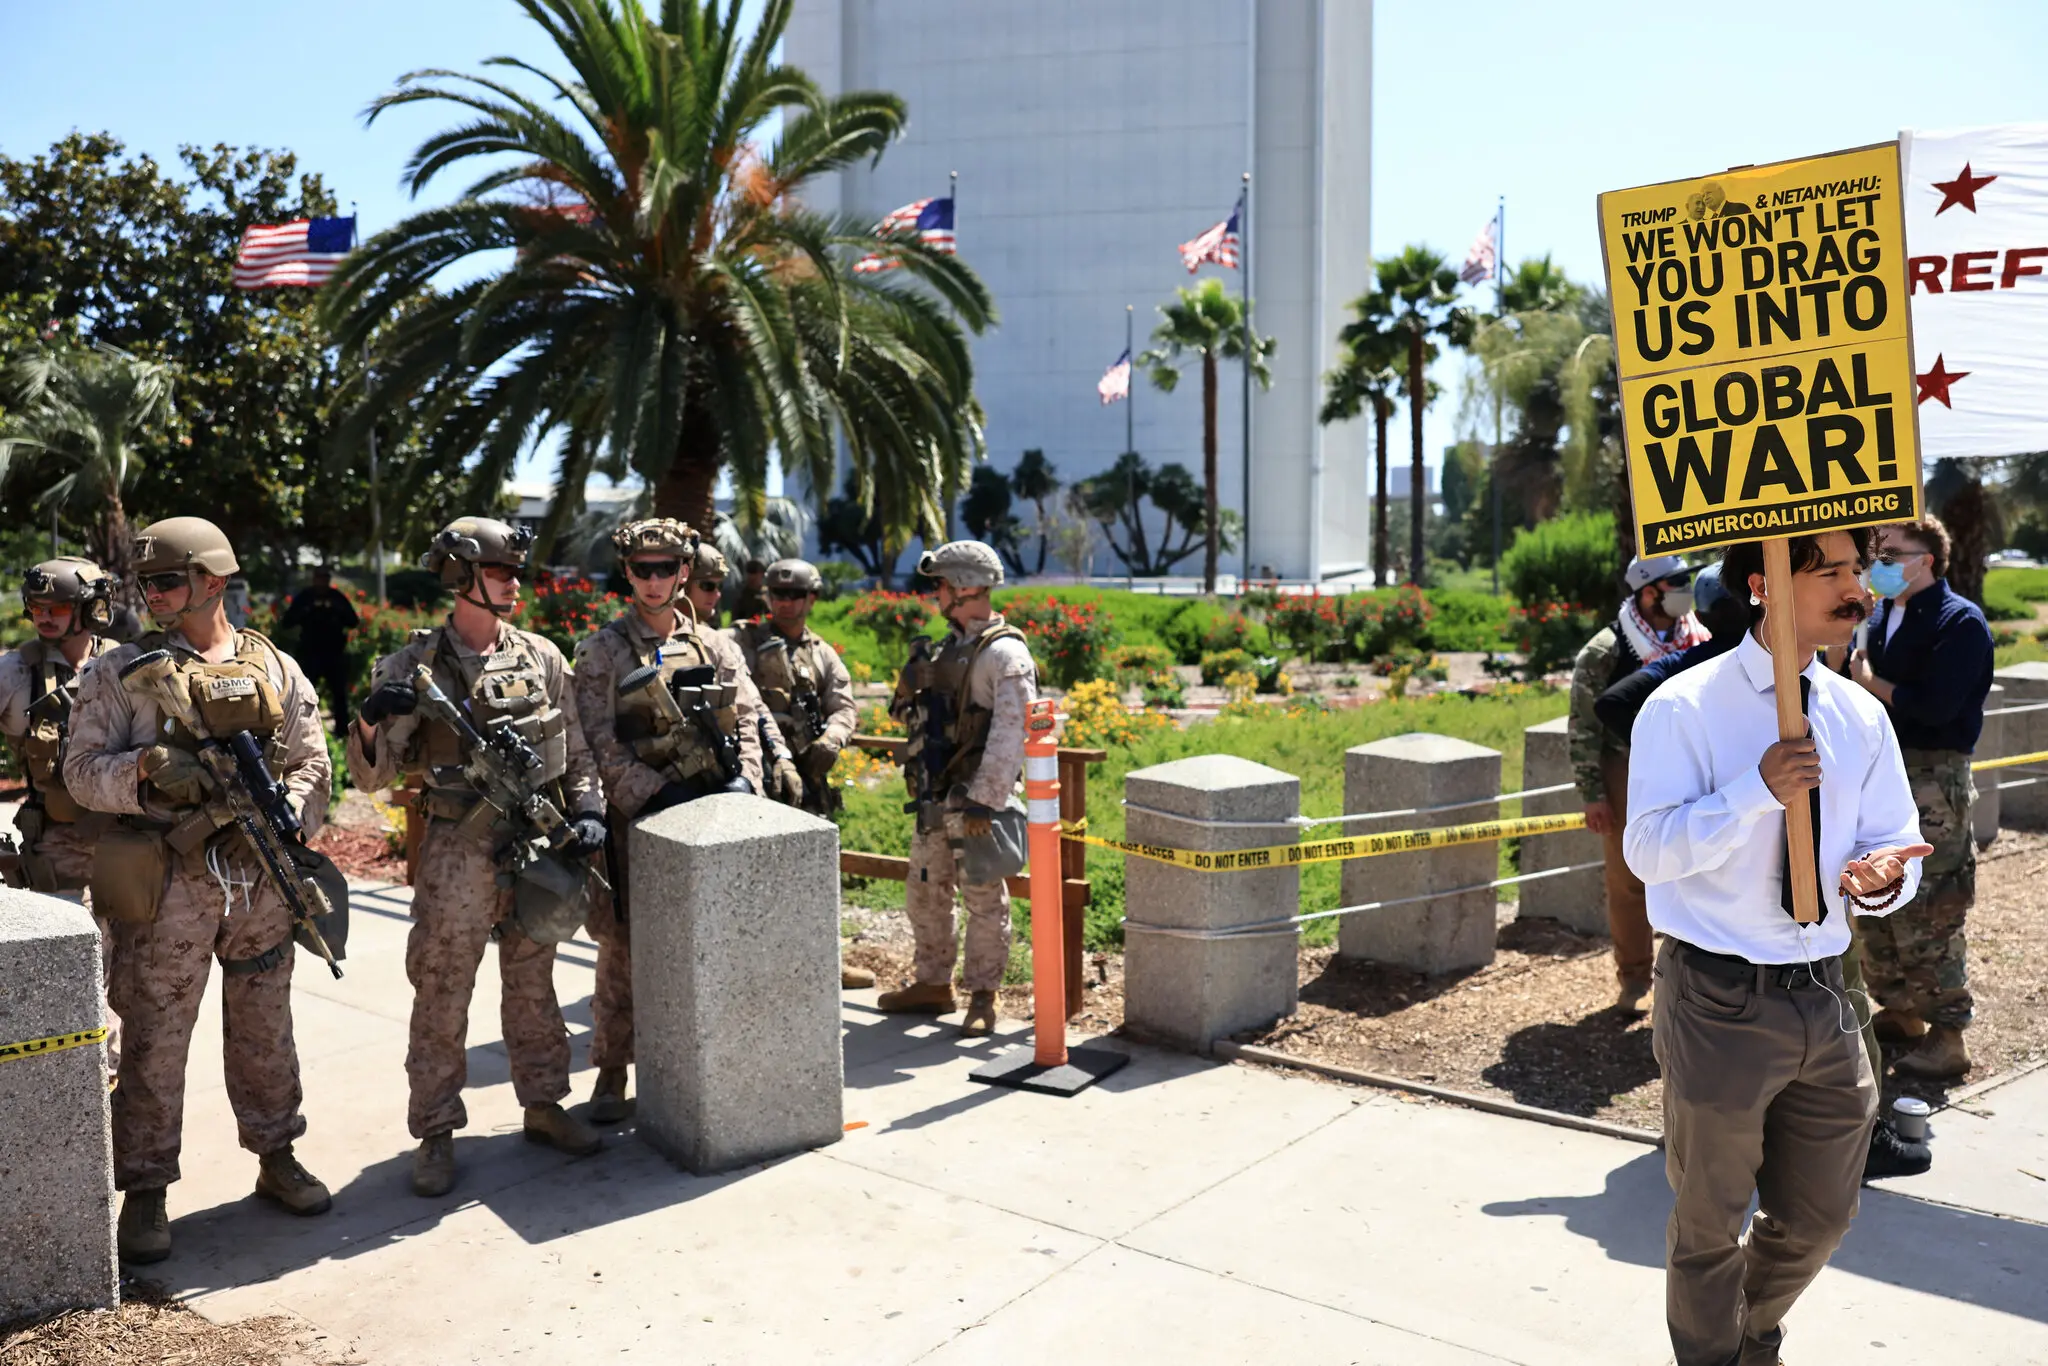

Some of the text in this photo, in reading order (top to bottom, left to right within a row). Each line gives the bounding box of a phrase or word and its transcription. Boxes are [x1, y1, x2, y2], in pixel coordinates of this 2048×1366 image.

[1621, 175, 1881, 228] TRUMP & NETANYAHU:
[1622, 193, 1881, 263] WE WON'T LET
[1626, 228, 1881, 306] YOU DRAG
[1908, 247, 2048, 296] REF
[1633, 275, 1888, 362] US INTO
[1643, 352, 1893, 438] GLOBAL
[1644, 407, 1898, 514] WAR!
[1655, 493, 1899, 545] ANSWERCOALITION.ORG
[212, 679, 251, 690] USMC
[1195, 851, 1270, 869] DO NOT ENTER
[1288, 842, 1355, 862] DO NOT ENTER
[1371, 832, 1431, 852] DO NOT ENTER
